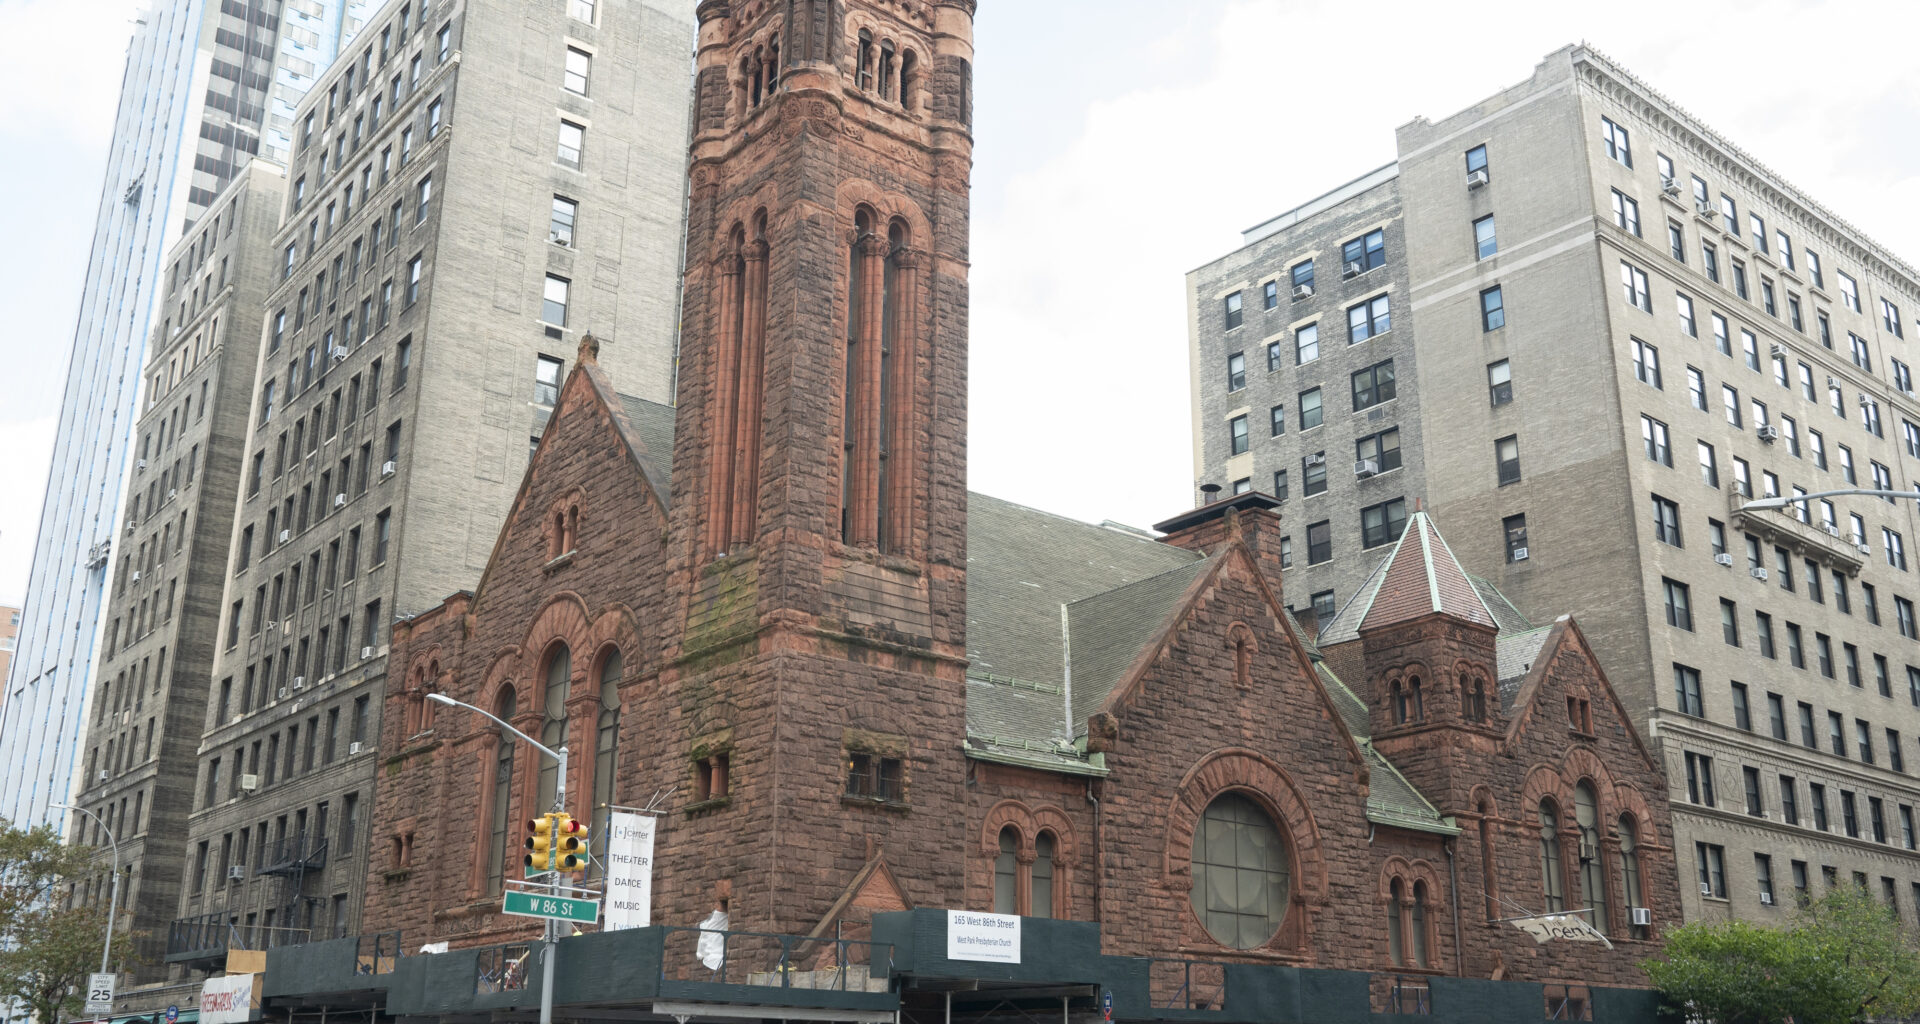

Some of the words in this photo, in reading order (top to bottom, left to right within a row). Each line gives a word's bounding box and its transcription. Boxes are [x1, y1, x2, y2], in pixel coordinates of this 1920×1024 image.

[612, 853, 648, 866] THEATER
[614, 877, 642, 889] DANCE
[530, 898, 540, 912] W
[543, 900, 557, 914] 86
[561, 902, 573, 916] St
[614, 900, 640, 911] MUSIC
[954, 915, 965, 925] 165
[967, 916, 981, 926] West
[983, 918, 996, 927] 86th
[997, 919, 1015, 929] Street
[91, 990, 110, 1000] 25
